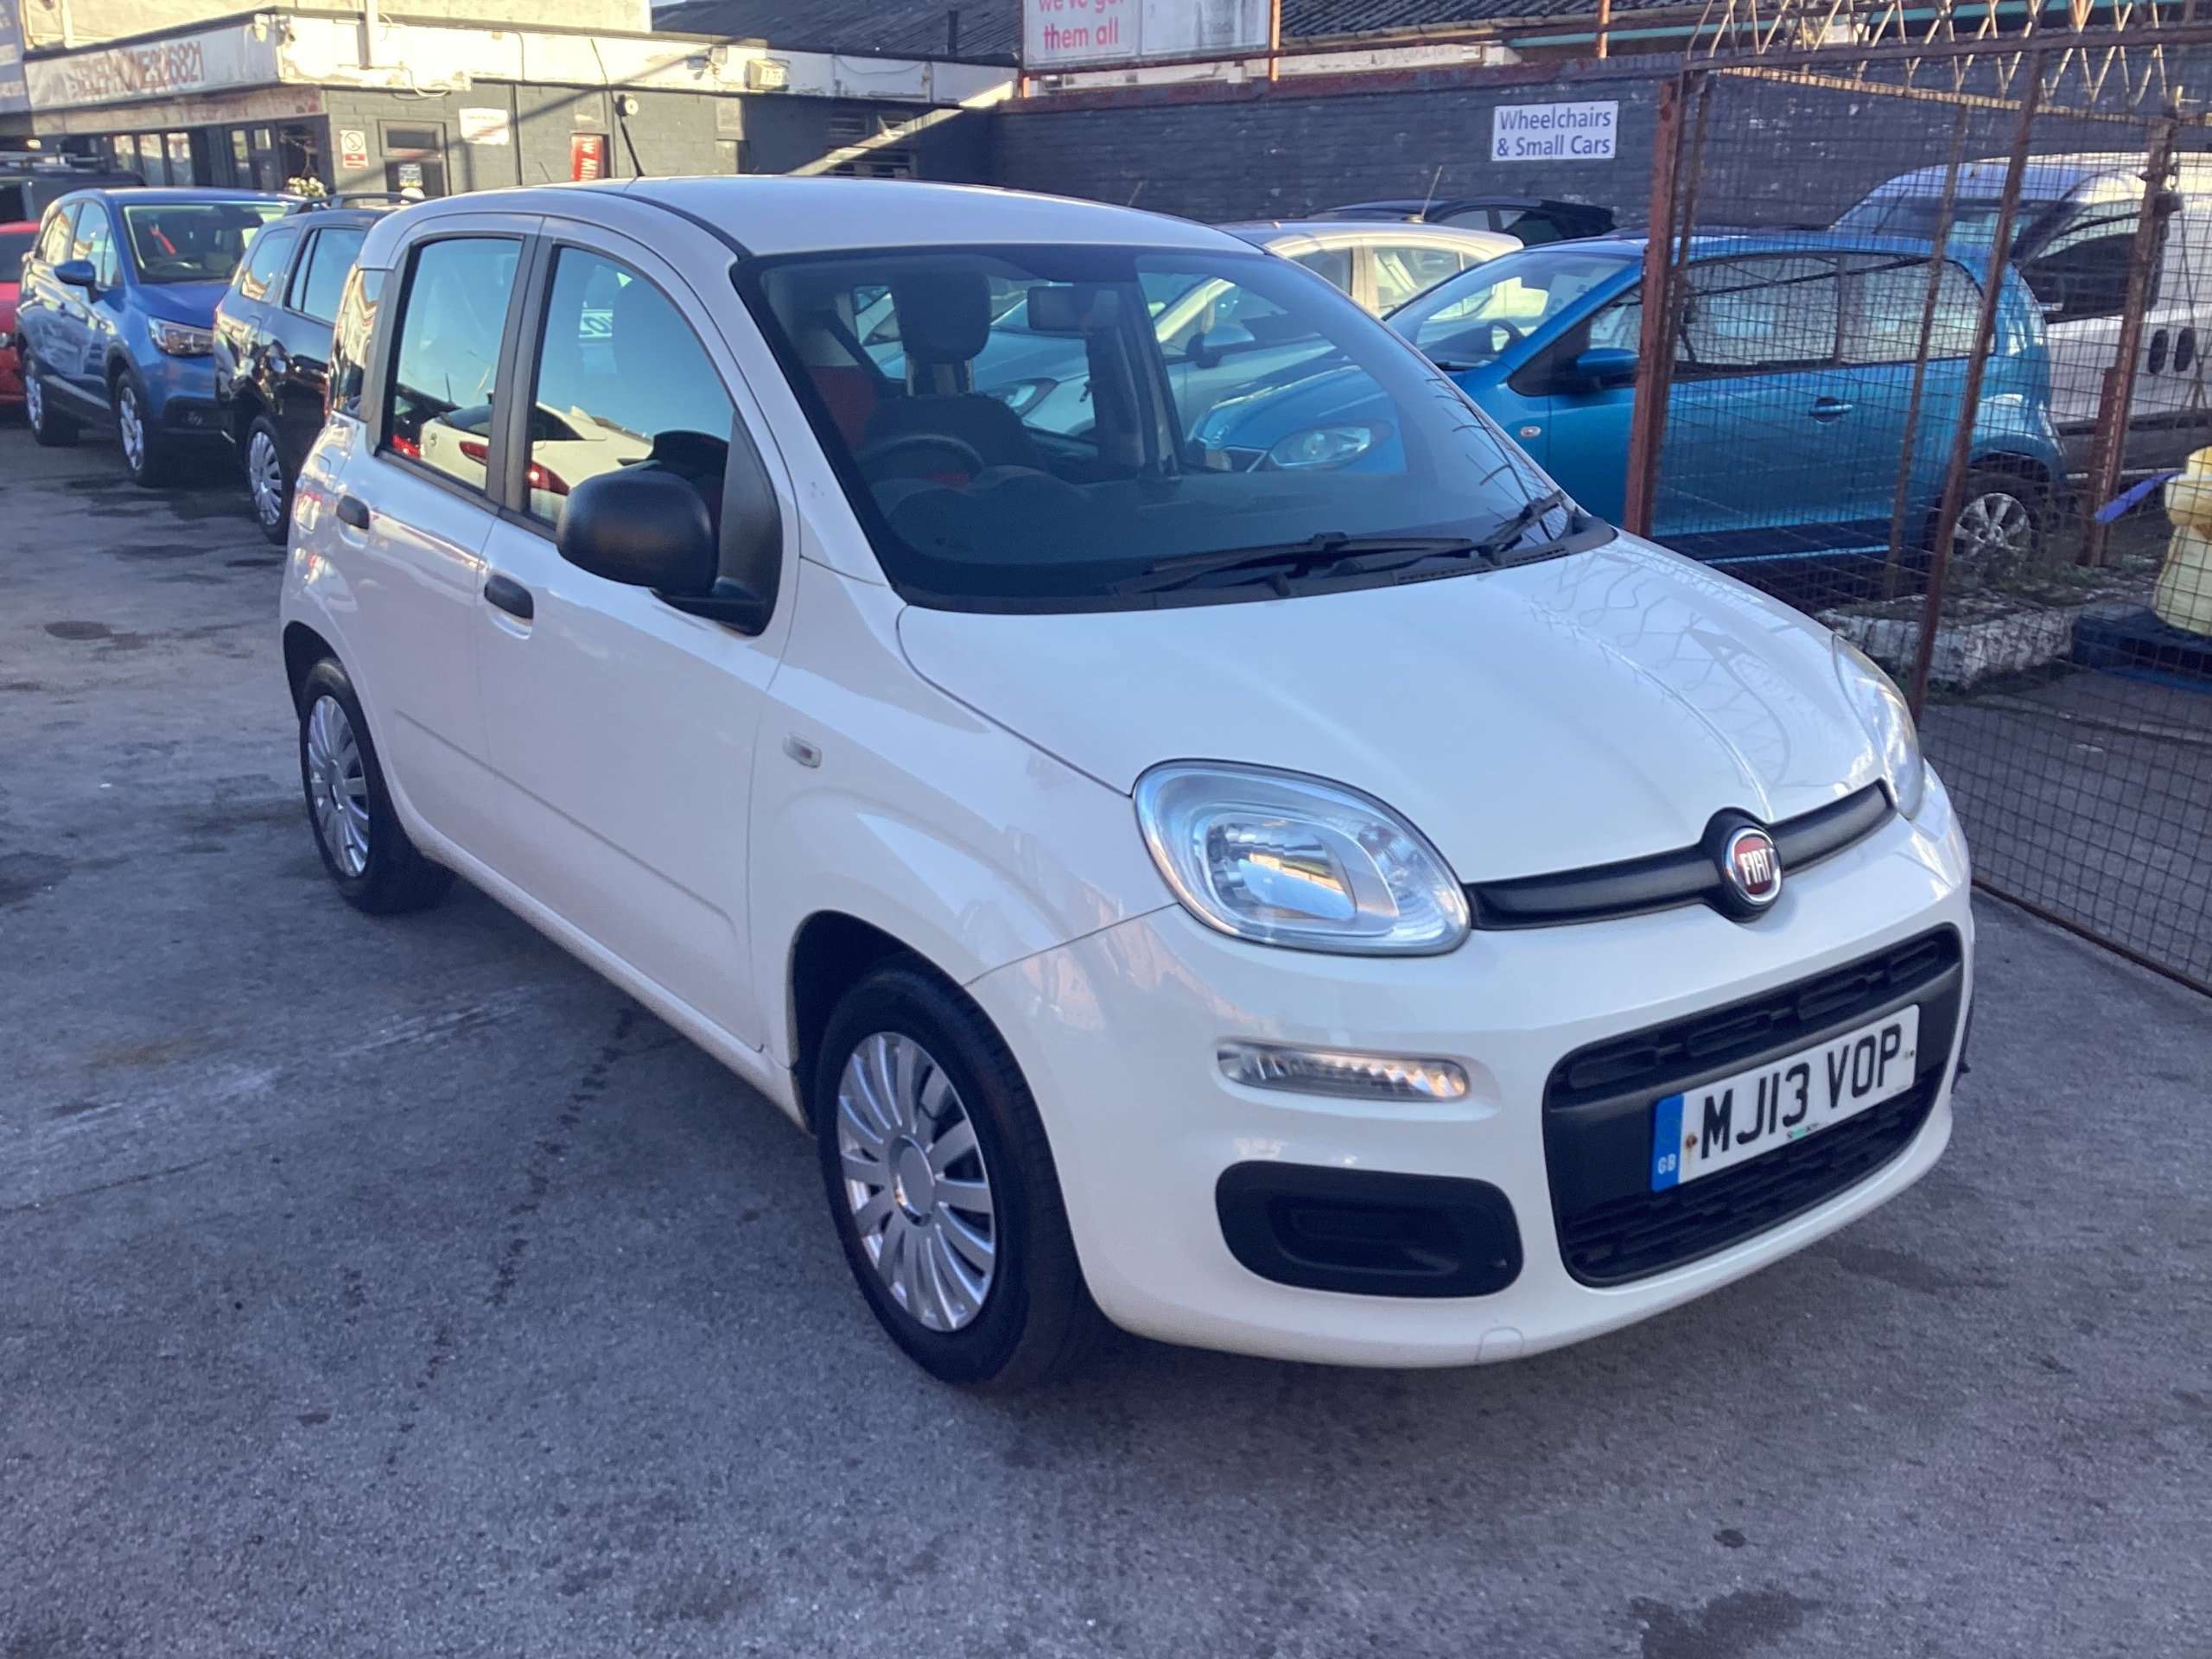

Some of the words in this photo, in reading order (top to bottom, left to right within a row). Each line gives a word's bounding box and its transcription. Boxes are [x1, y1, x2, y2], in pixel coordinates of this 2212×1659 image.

[1043, 22, 1089, 49] them
[1096, 16, 1119, 45] all
[1500, 105, 1611, 130] Wheelchairs
[1497, 137, 1510, 156] &
[1516, 134, 1565, 156] Small
[1571, 135, 1611, 155] Cars
[1739, 849, 1771, 886] FIAT
[1700, 1062, 1810, 1160] MJ13
[1827, 1023, 1902, 1109] VOP
[1657, 1154, 1677, 1175] GB
